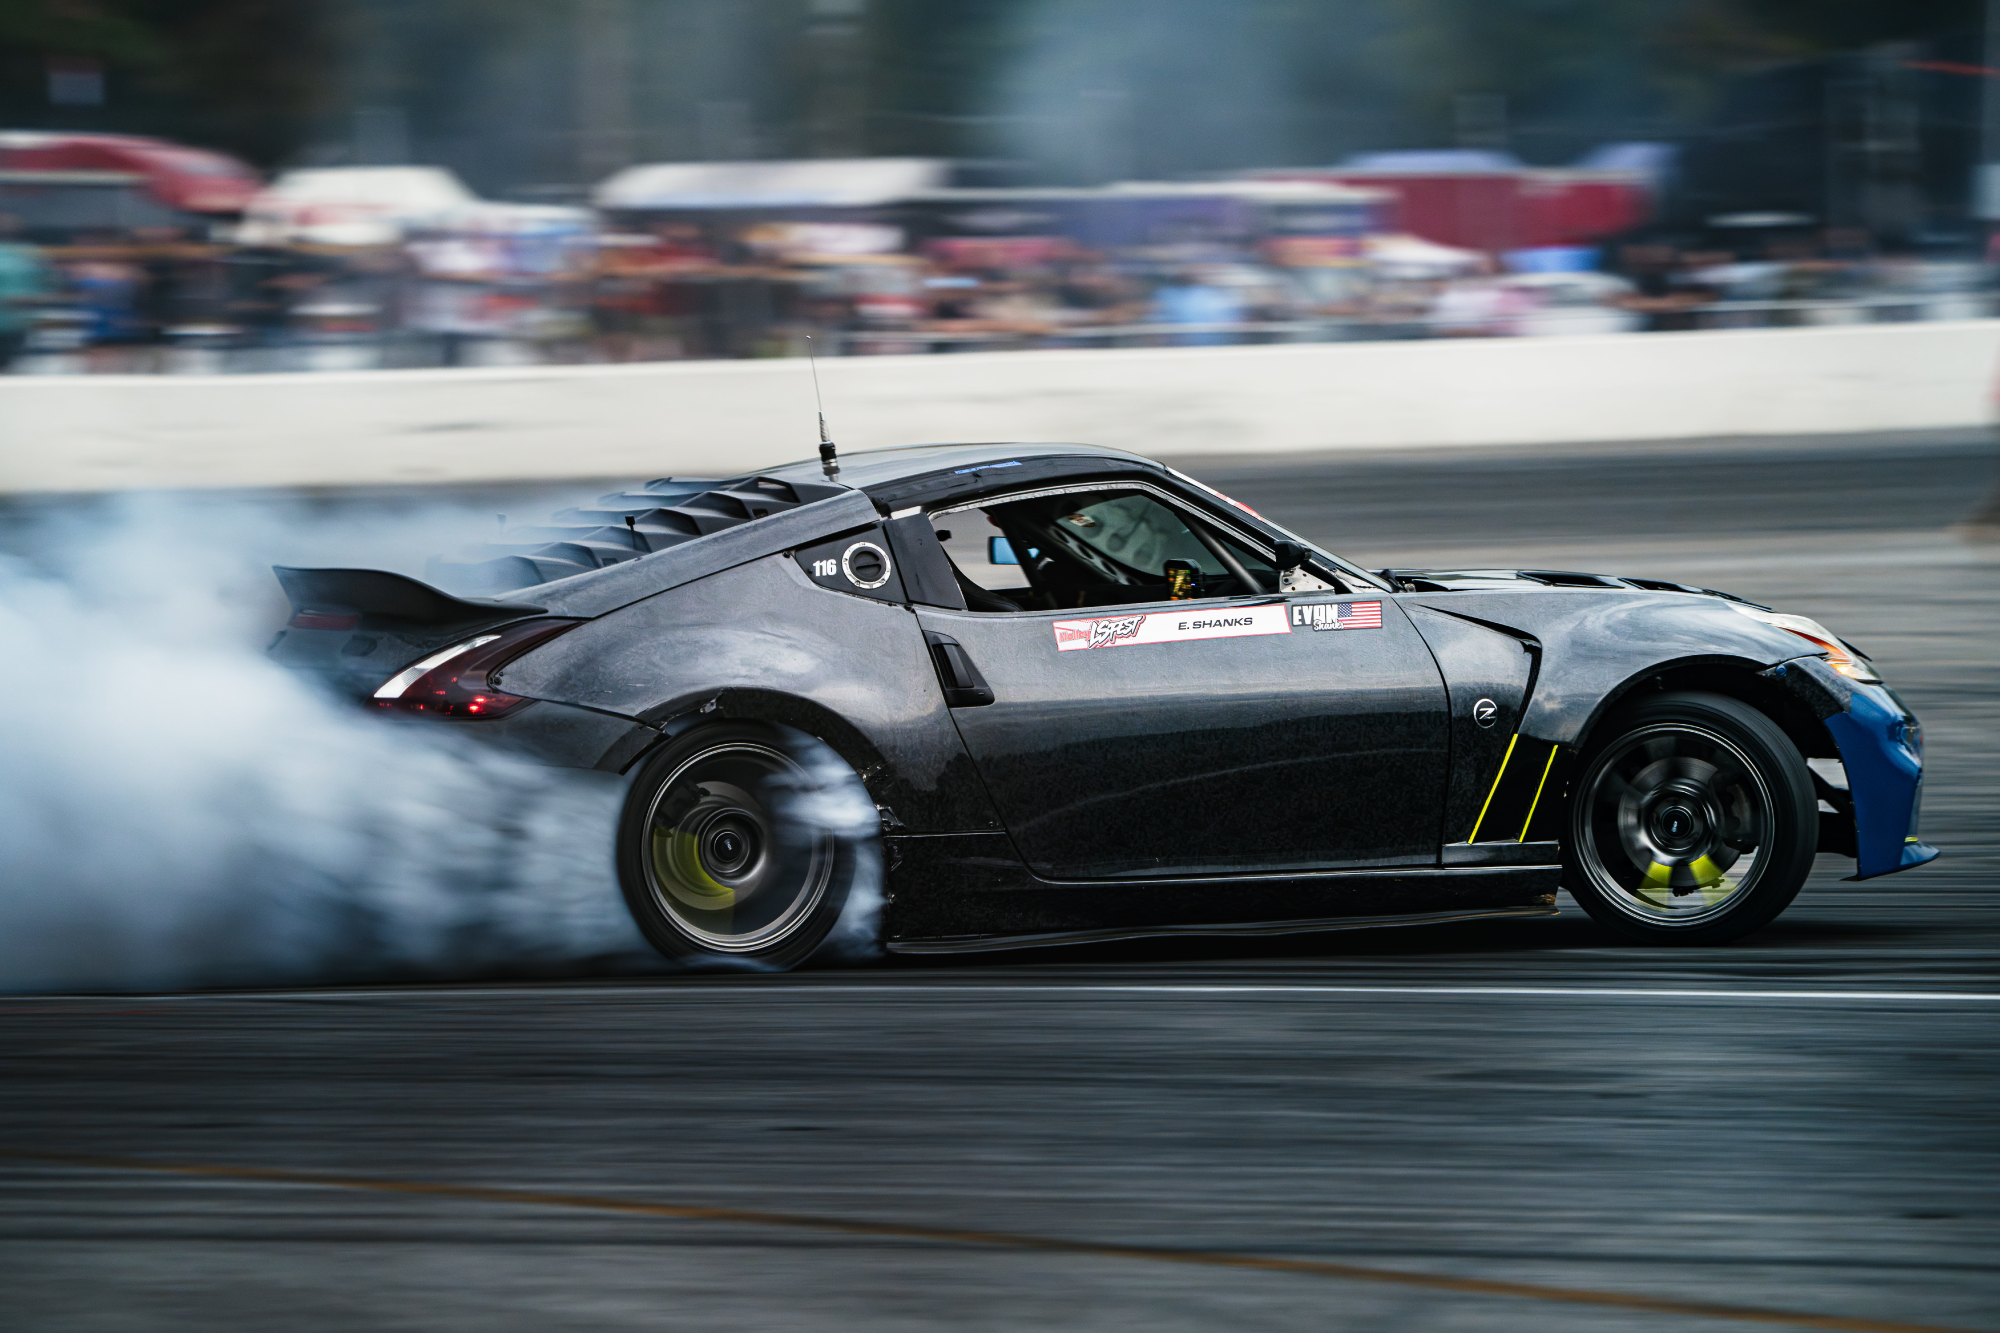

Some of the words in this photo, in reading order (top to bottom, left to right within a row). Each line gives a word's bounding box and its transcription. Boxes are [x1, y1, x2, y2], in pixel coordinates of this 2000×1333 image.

[813, 559, 837, 577] 116
[1178, 621, 1190, 631] E.
[1192, 617, 1253, 629] SHANKS
[1060, 629, 1091, 642] Holley
